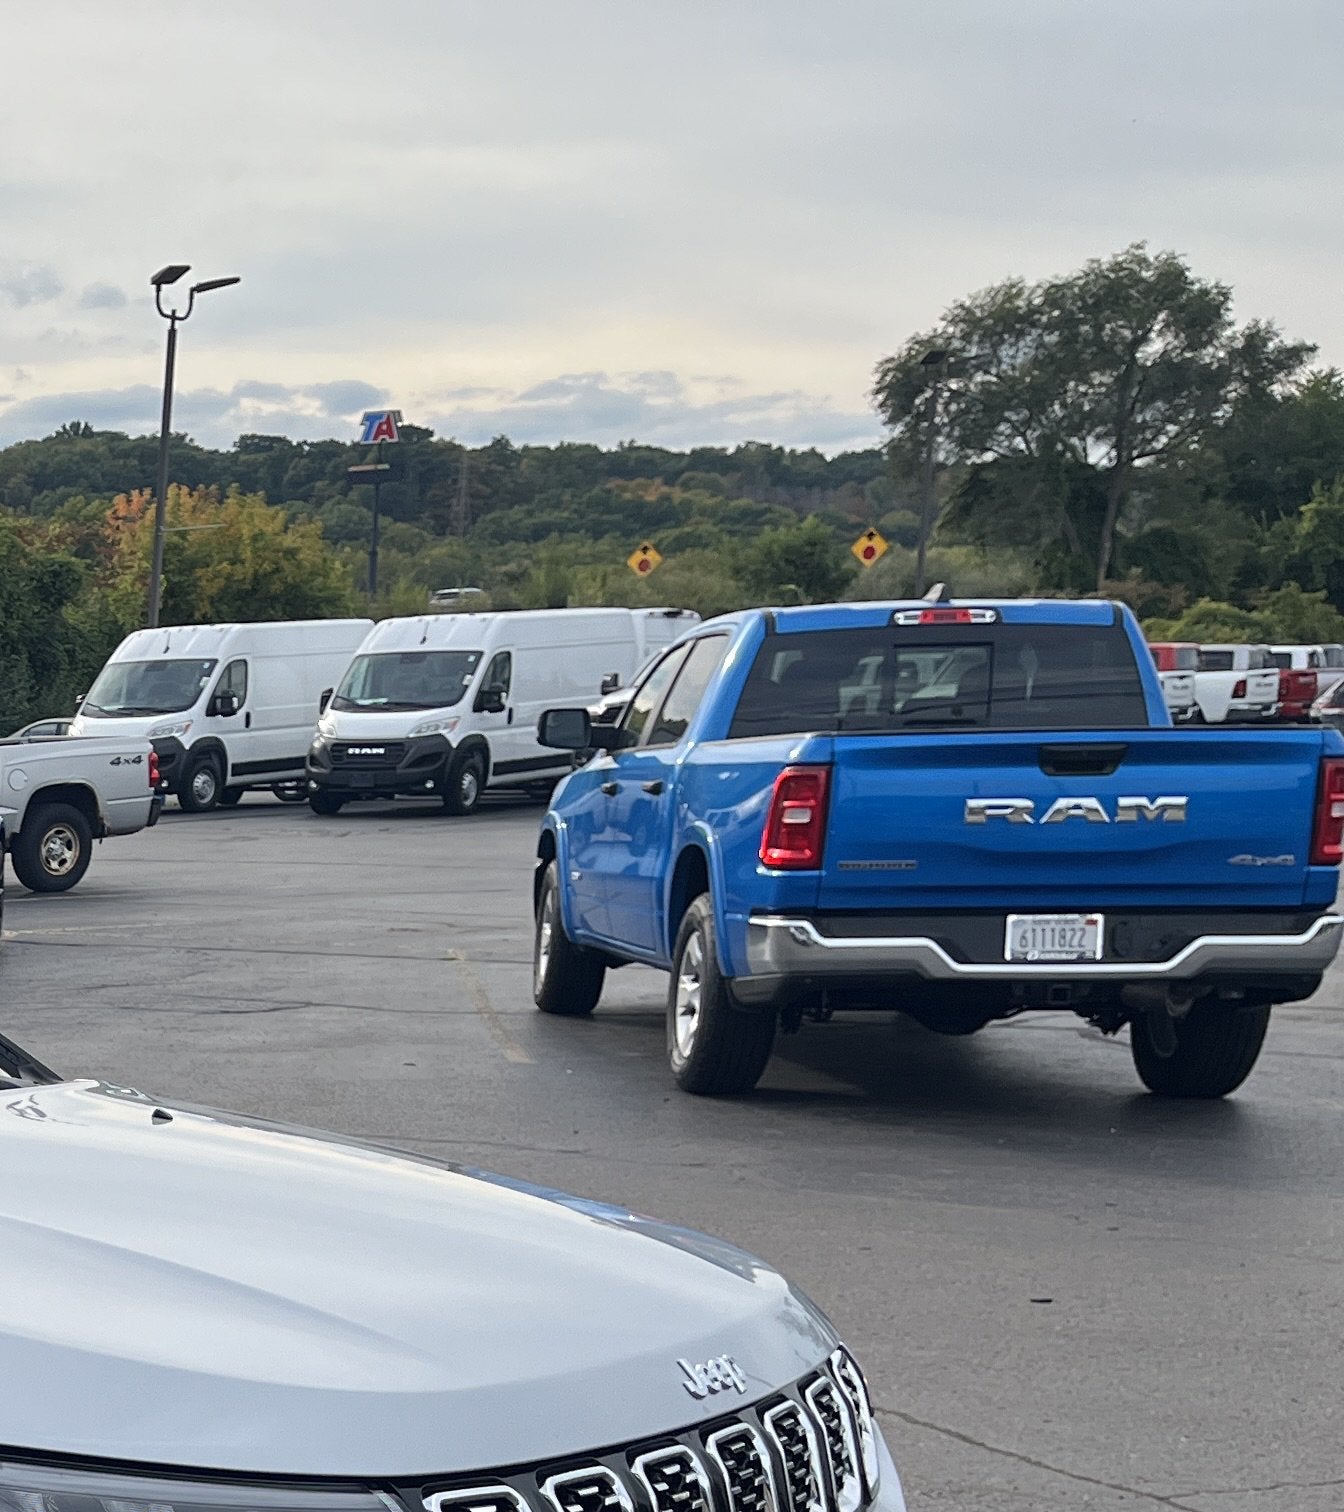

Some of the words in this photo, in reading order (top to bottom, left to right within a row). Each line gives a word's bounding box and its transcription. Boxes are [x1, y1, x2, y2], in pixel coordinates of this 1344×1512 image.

[362, 412, 398, 443] TA
[109, 755, 143, 766] 4x4
[347, 747, 385, 755] RAM
[964, 795, 1188, 825] RAM
[676, 1354, 747, 1400] Jeep
